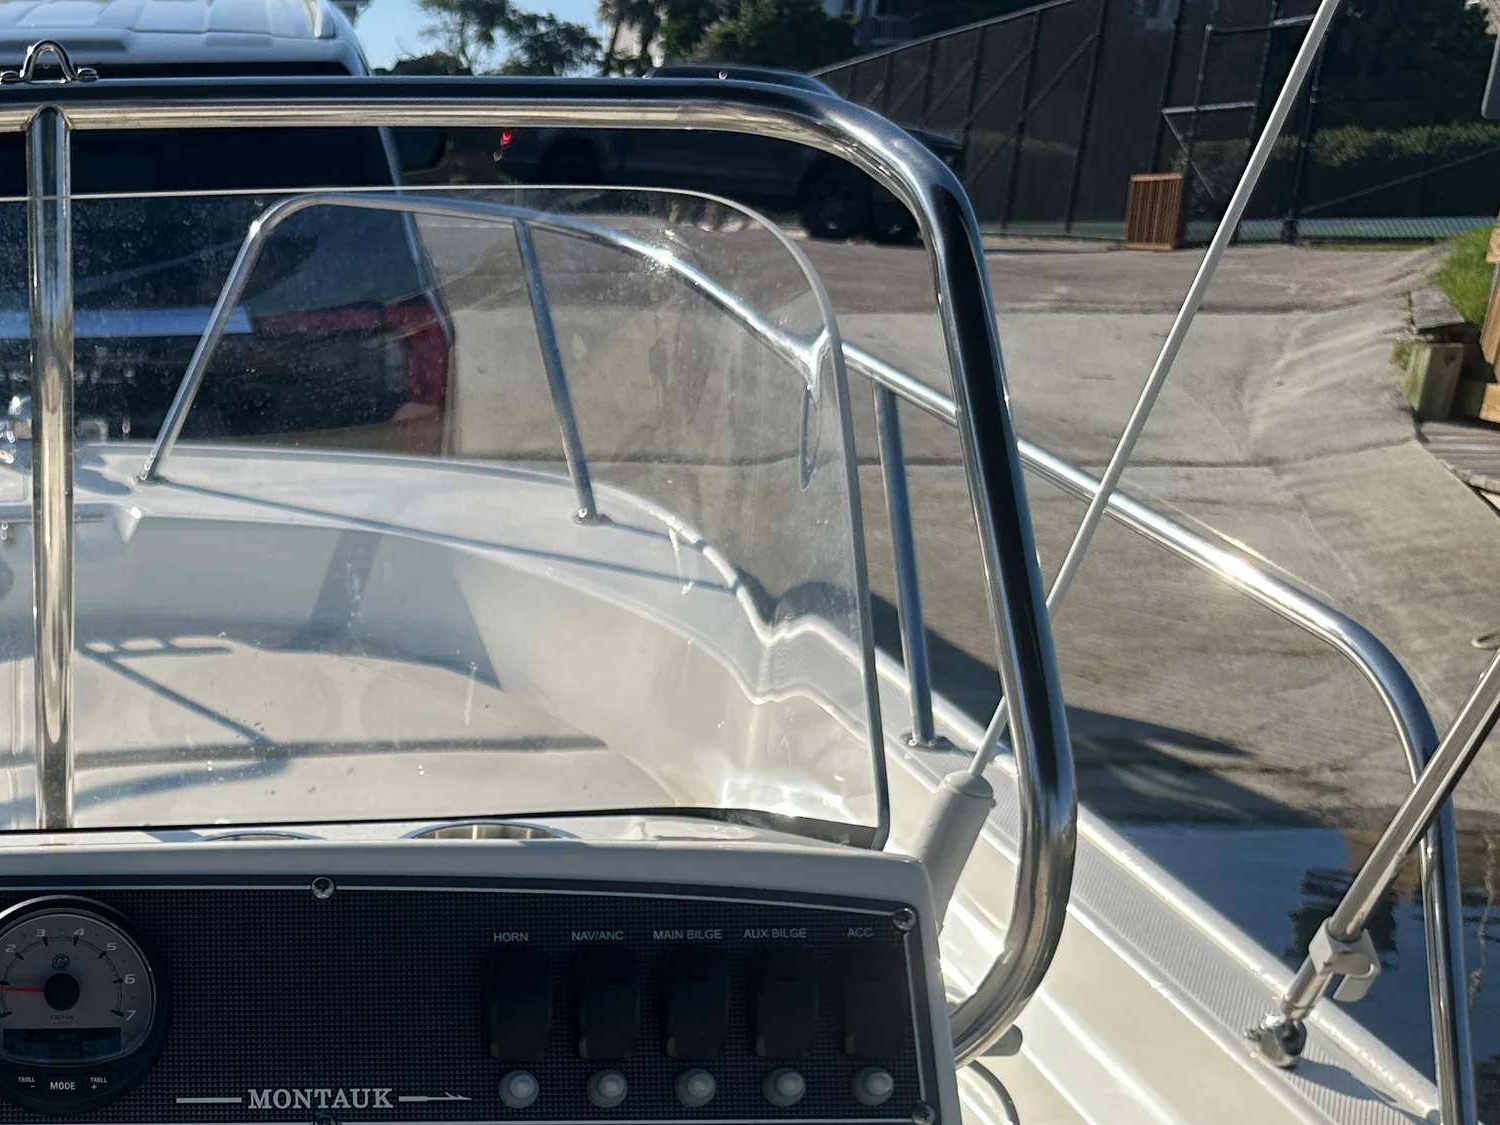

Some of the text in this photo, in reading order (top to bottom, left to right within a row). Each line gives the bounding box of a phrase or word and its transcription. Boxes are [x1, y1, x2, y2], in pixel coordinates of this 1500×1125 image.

[35, 928, 85, 937] 3 4
[493, 932, 529, 942] HORN
[571, 930, 625, 942] NAV/ANC
[653, 929, 722, 941] MAIN BILGE
[743, 928, 807, 939] AUX BILGE
[846, 927, 872, 938] ACC
[6, 943, 117, 953] 2 5
[124, 974, 136, 984] 6
[126, 1010, 136, 1021] 7
[50, 1082, 76, 1090] MODE
[247, 1088, 393, 1110] MONTAUK
